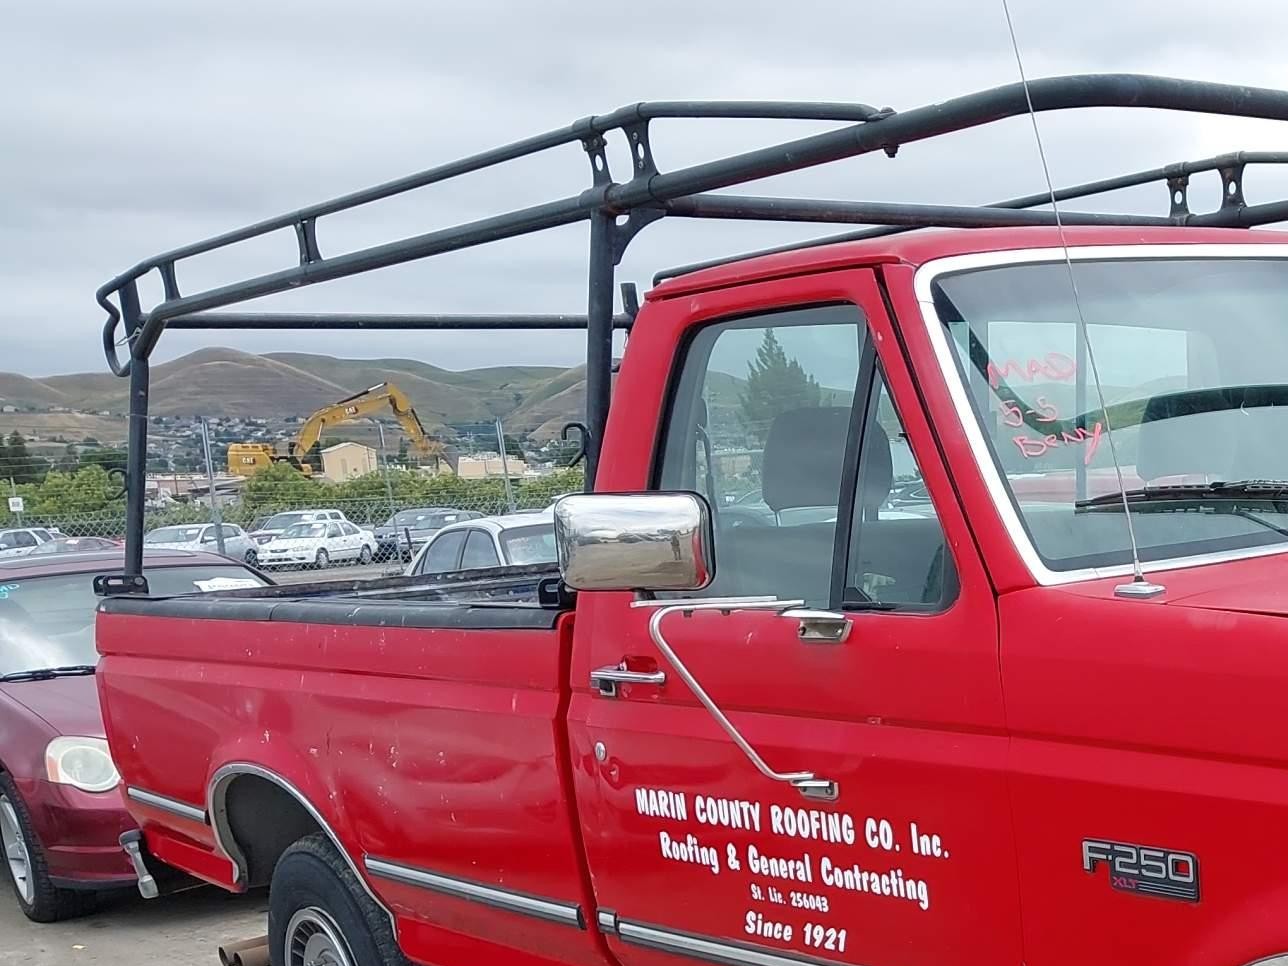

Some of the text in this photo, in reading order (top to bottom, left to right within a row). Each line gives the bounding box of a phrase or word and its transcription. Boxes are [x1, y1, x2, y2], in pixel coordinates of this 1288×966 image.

[635, 787, 950, 859] MARIN COUNTY ROOFING CO. Inc.
[659, 831, 929, 911] Roofing & General Contracting
[744, 910, 847, 953] Since 1921
